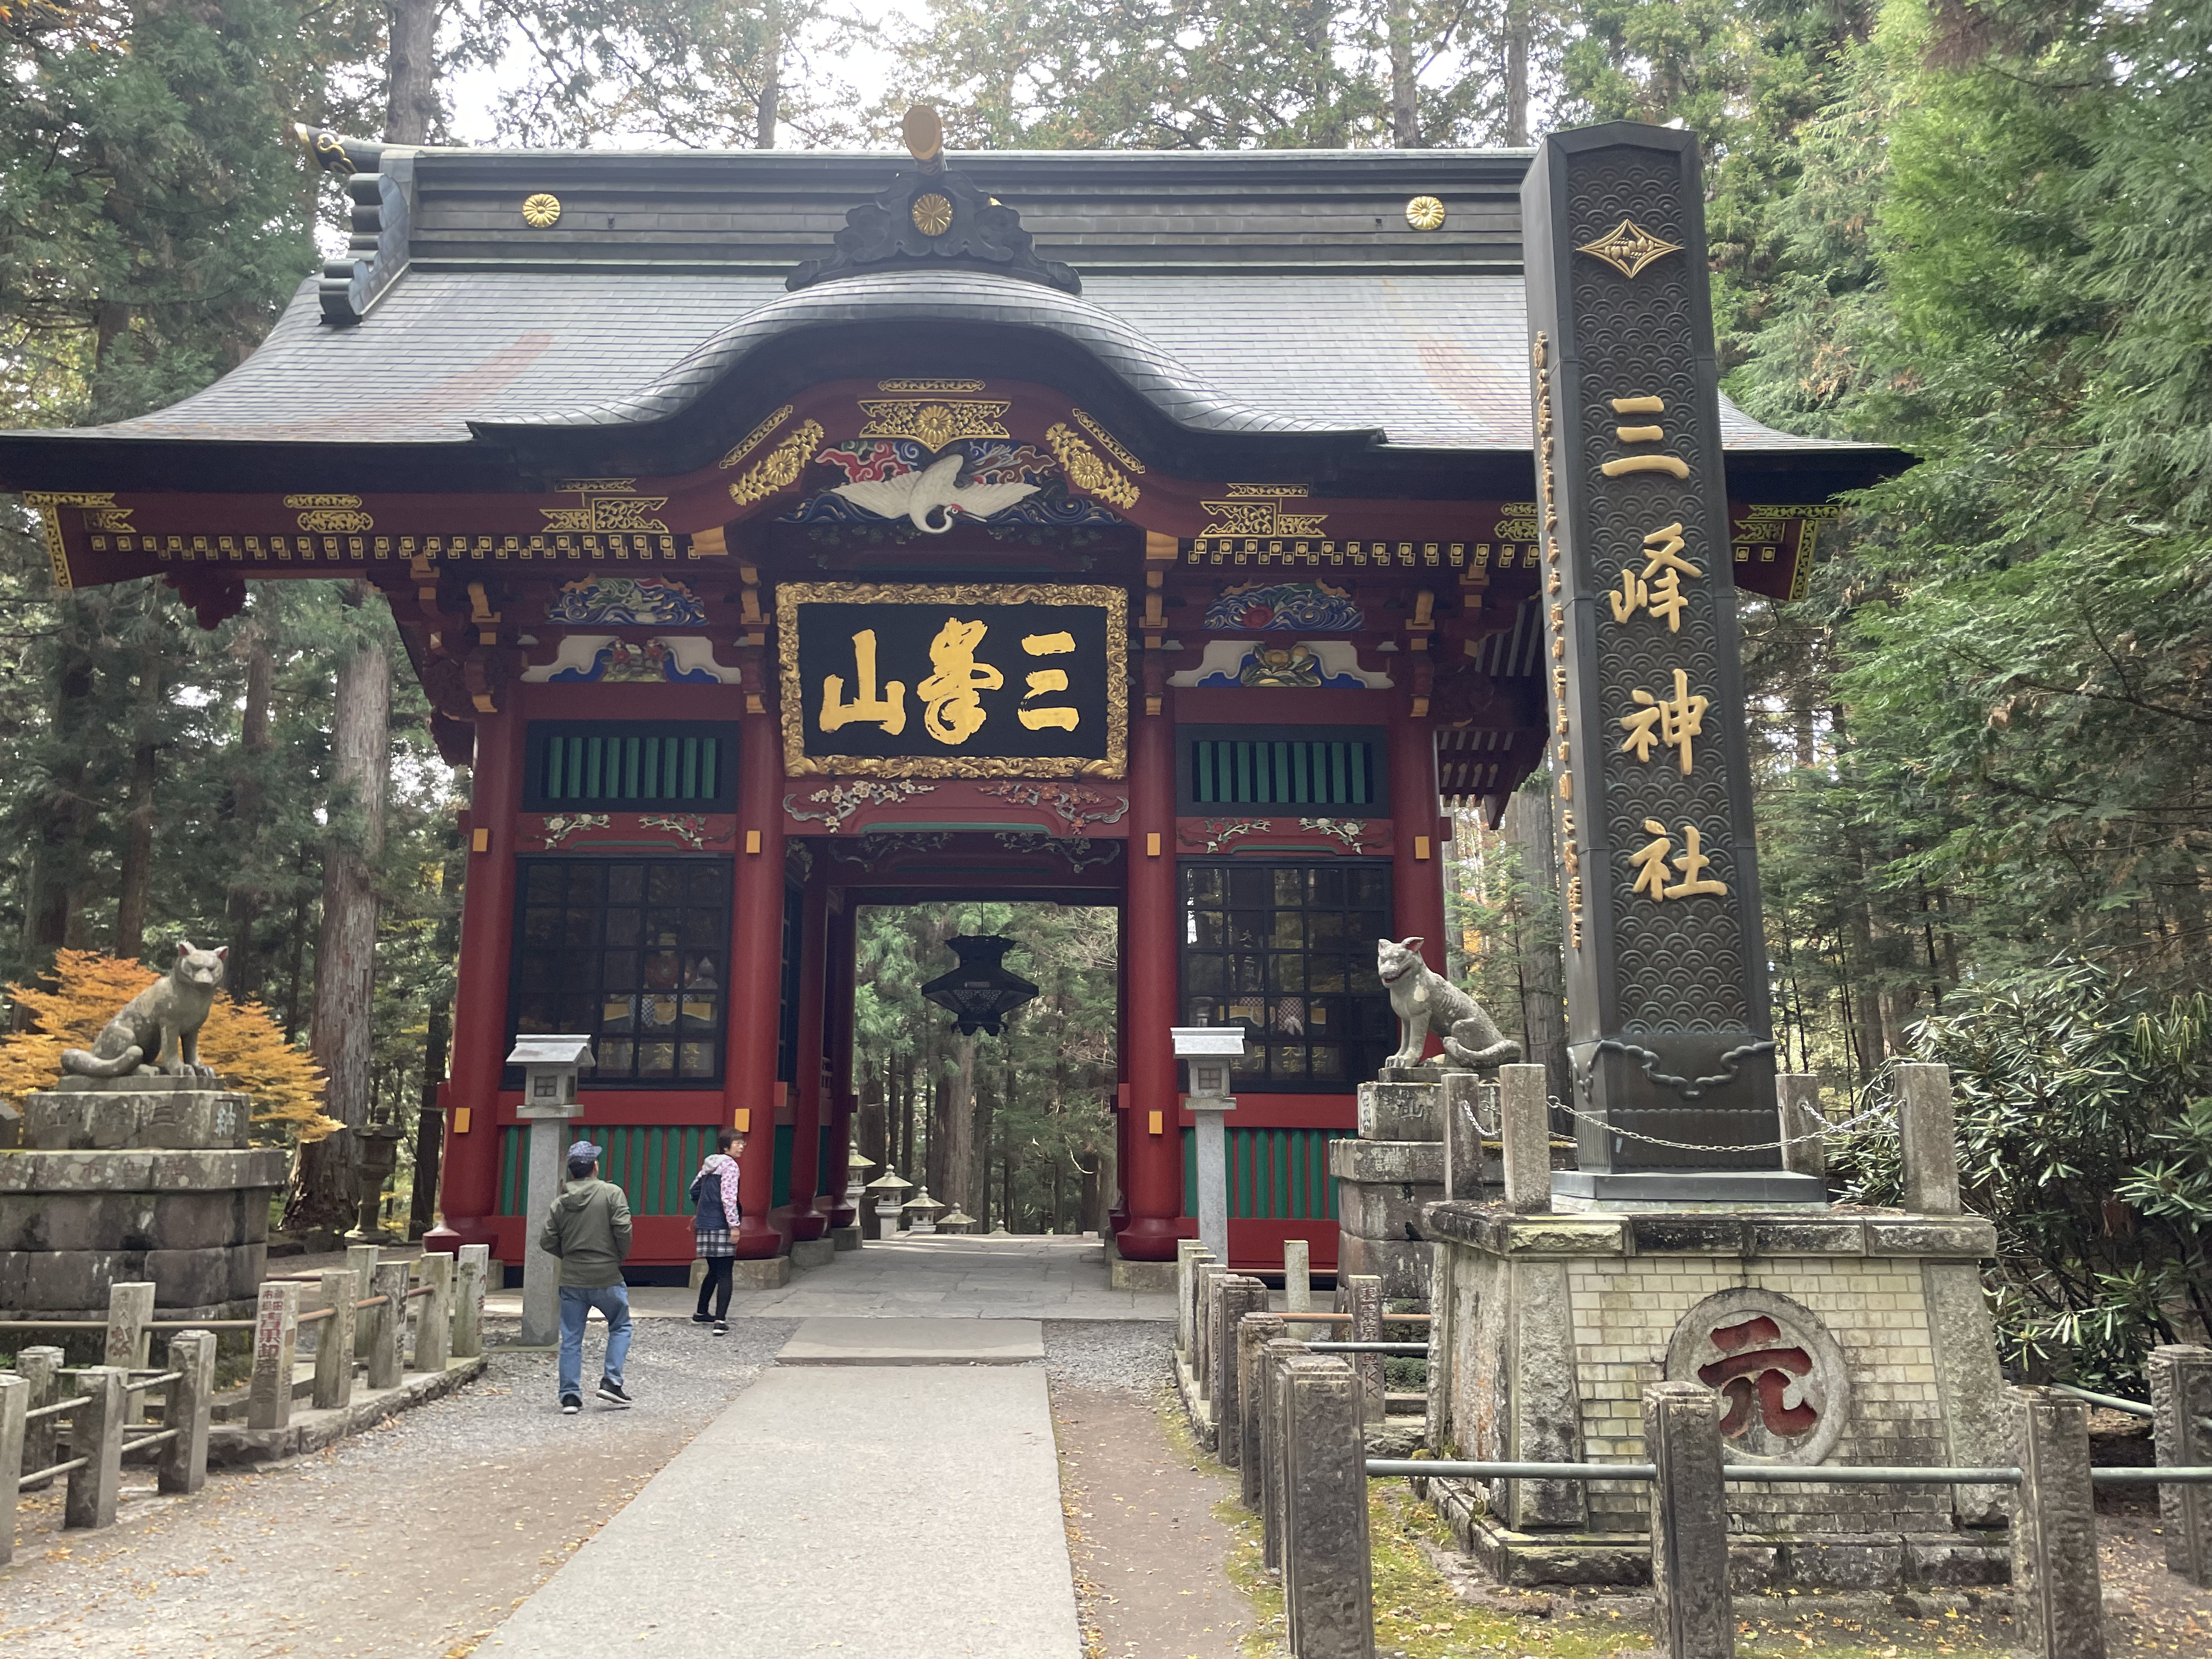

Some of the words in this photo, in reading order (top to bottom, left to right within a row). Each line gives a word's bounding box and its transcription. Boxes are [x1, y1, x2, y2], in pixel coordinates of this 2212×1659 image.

[1602, 395, 1728, 902] 三峰神社
[1697, 1315, 1818, 1438] 元
